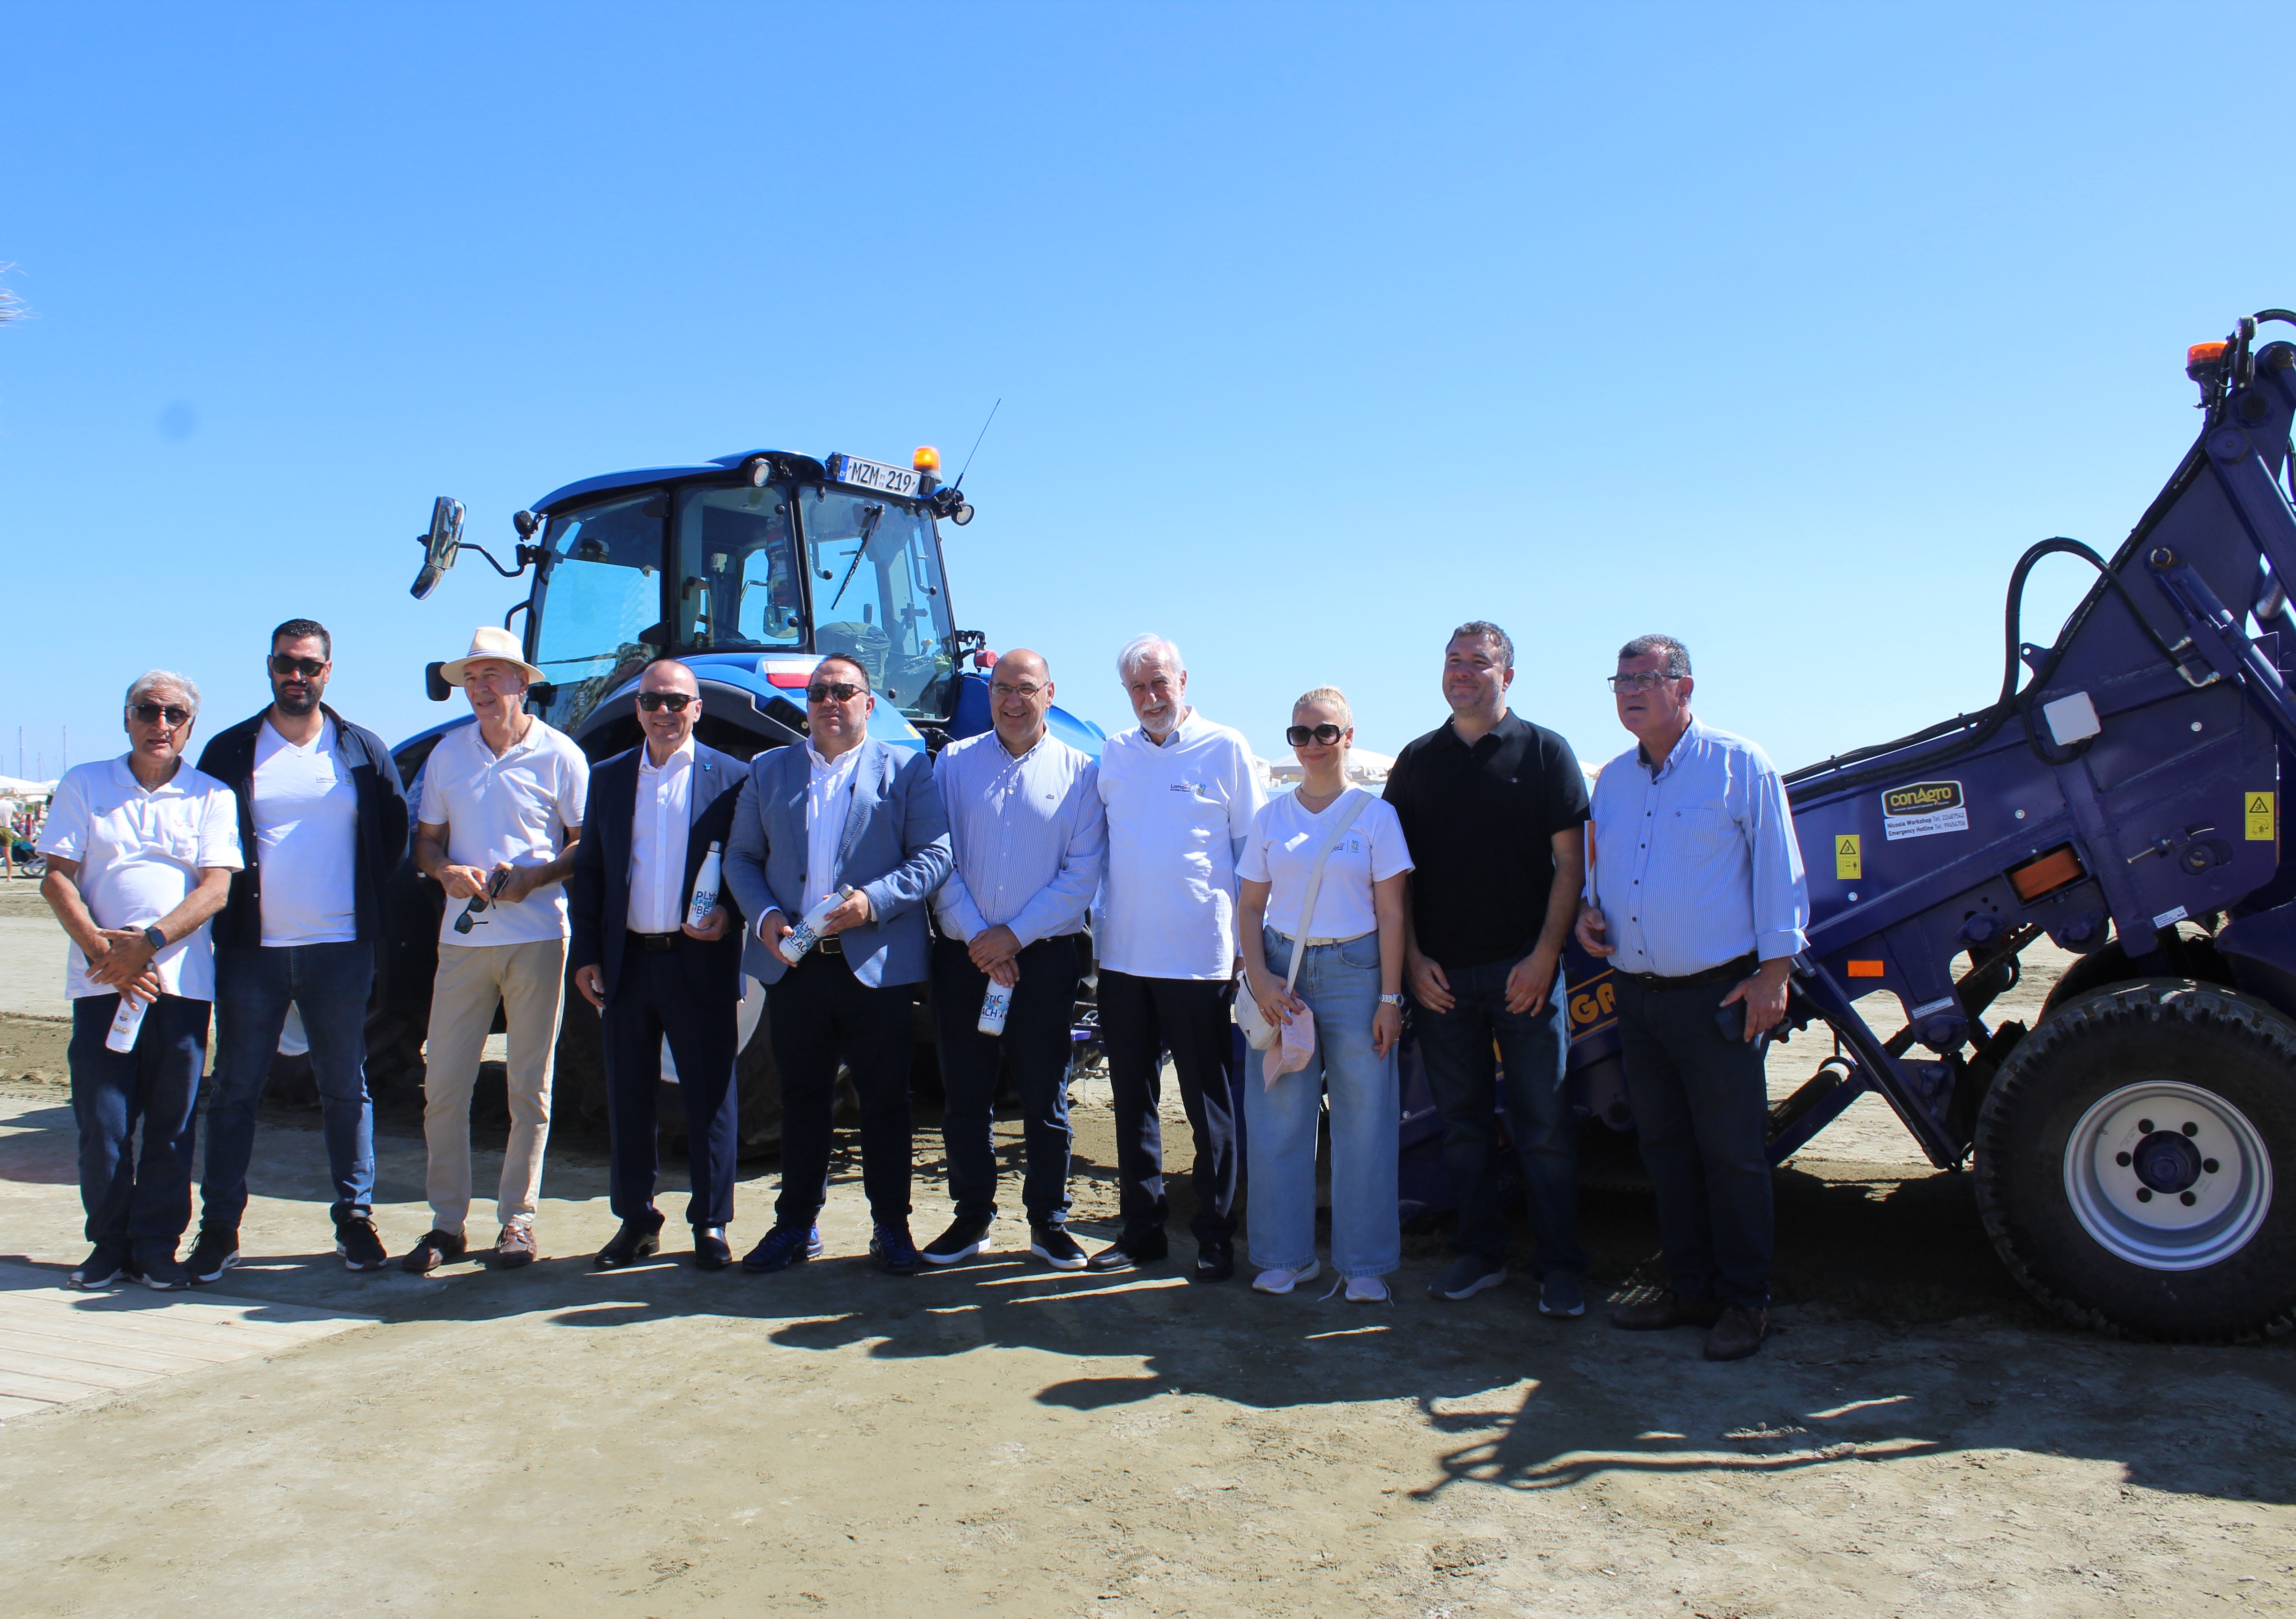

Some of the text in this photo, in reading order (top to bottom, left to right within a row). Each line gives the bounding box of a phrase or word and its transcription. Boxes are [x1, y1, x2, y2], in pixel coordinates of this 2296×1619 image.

[851, 461, 912, 492] MZM 219
[1890, 787, 1952, 806] conAgro
[1942, 812, 1964, 821] 22487542
[794, 927, 807, 942] FREE
